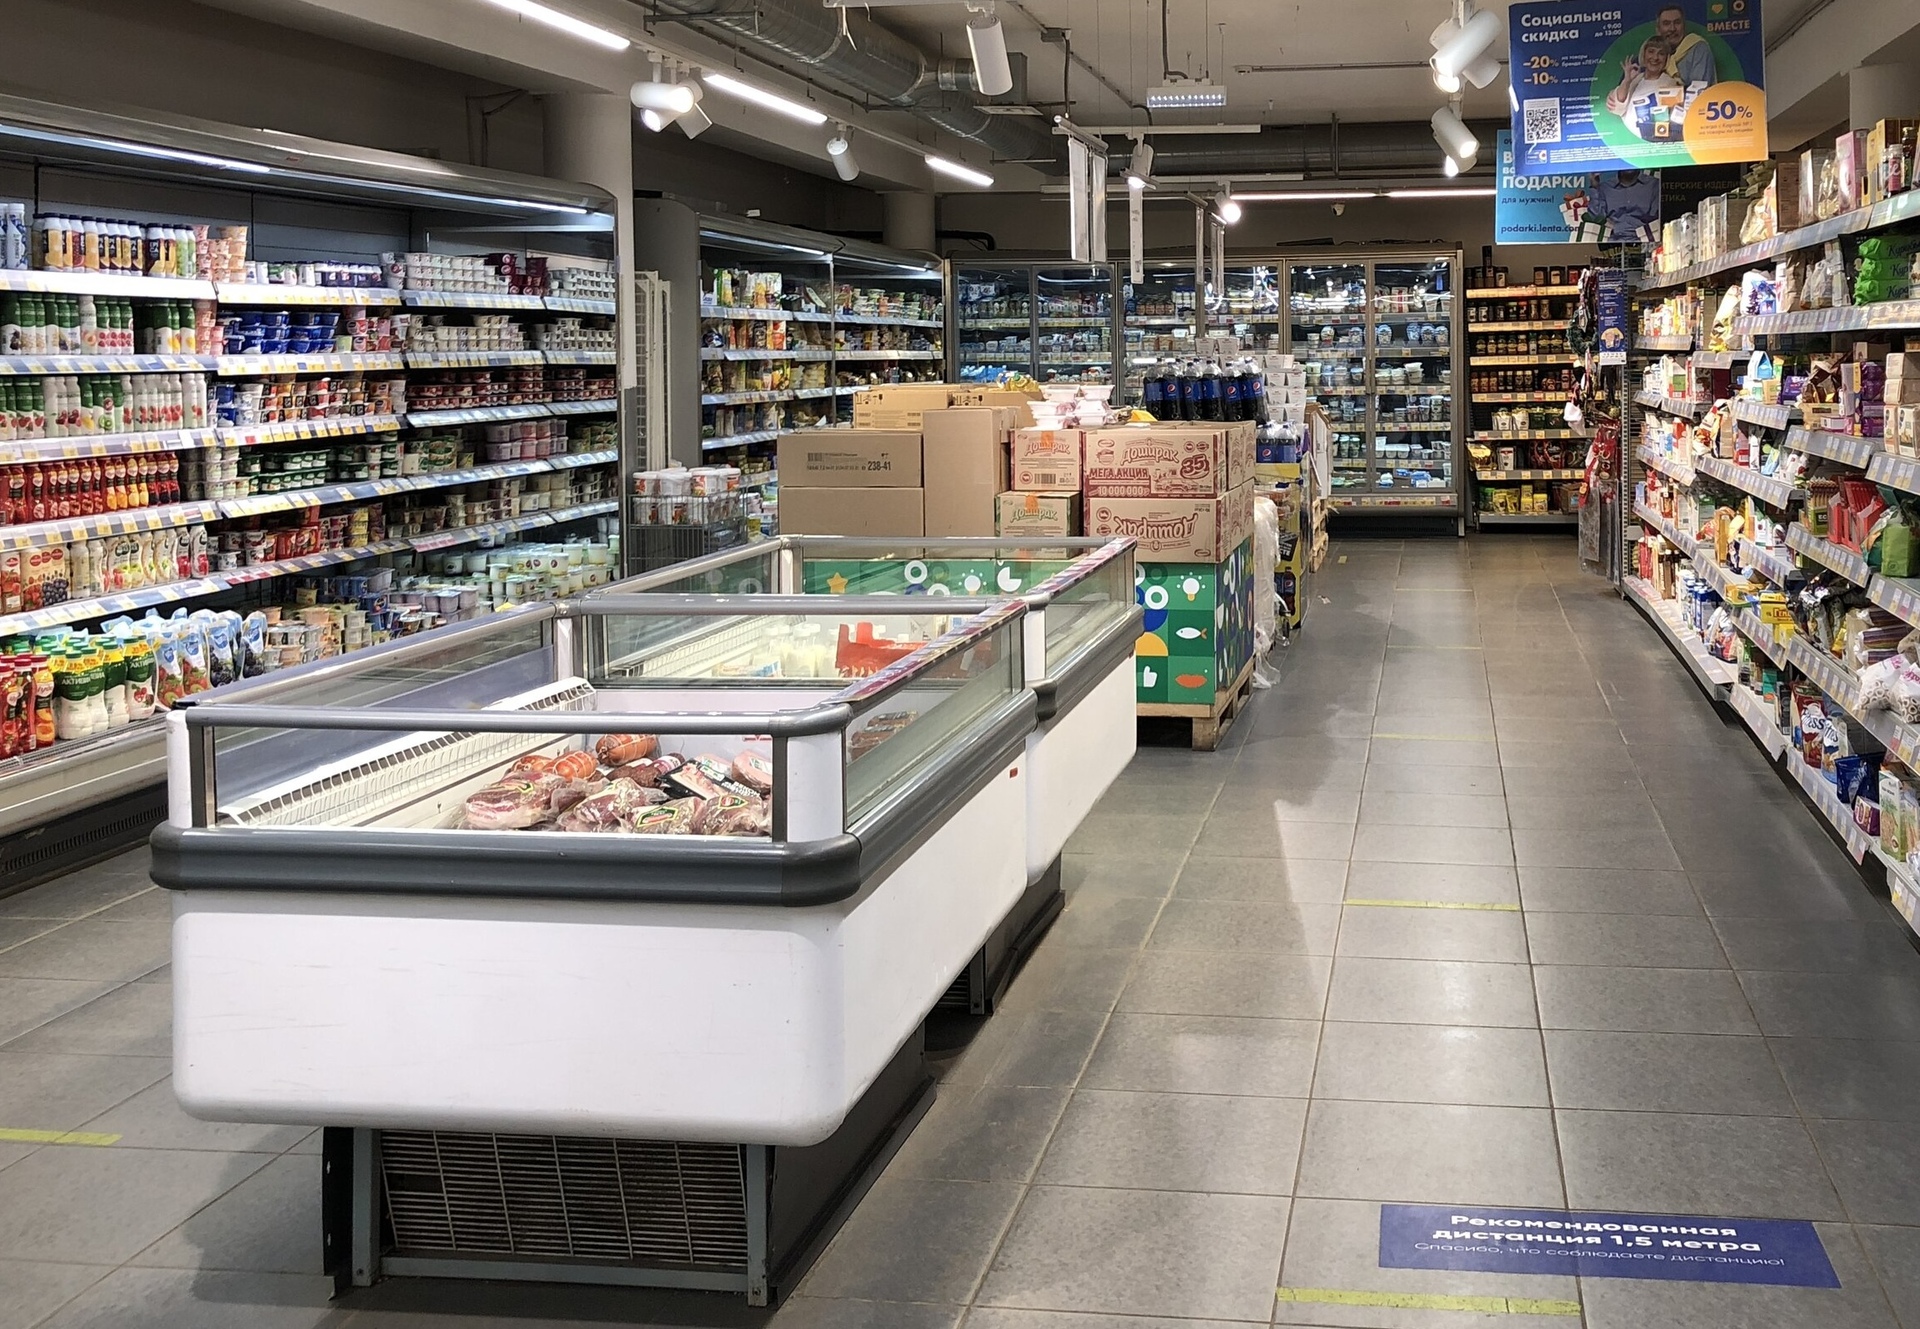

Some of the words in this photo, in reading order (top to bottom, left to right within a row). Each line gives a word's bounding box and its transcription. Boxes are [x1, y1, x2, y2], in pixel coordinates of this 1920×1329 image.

[1521, 10, 1621, 27] Социальная
[1707, 20, 1751, 32] ВМЕСТЕ
[1521, 29, 1579, 42] скидка
[1502, 176, 1585, 190] ПОДАРКИ
[1518, 194, 1555, 205] мужчин!
[1120, 446, 1180, 466] Доширак
[867, 461, 892, 471] 238-41
[1181, 453, 1210, 477] 35
[1089, 468, 1116, 479] МЕГА
[1117, 468, 1149, 480] АКЦИЯ
[1114, 512, 1199, 539] Доширак
[1451, 1215, 1737, 1237] Рекомендованная
[1432, 1230, 1602, 1245] дистанция
[1610, 1235, 1653, 1247] 1,5
[1662, 1239, 1762, 1252] метра
[1414, 1242, 1503, 1254] Спасибо,
[1509, 1247, 1541, 1255] что
[1546, 1248, 1666, 1260] соблюдаете
[1671, 1254, 1785, 1266] дистанцию!
